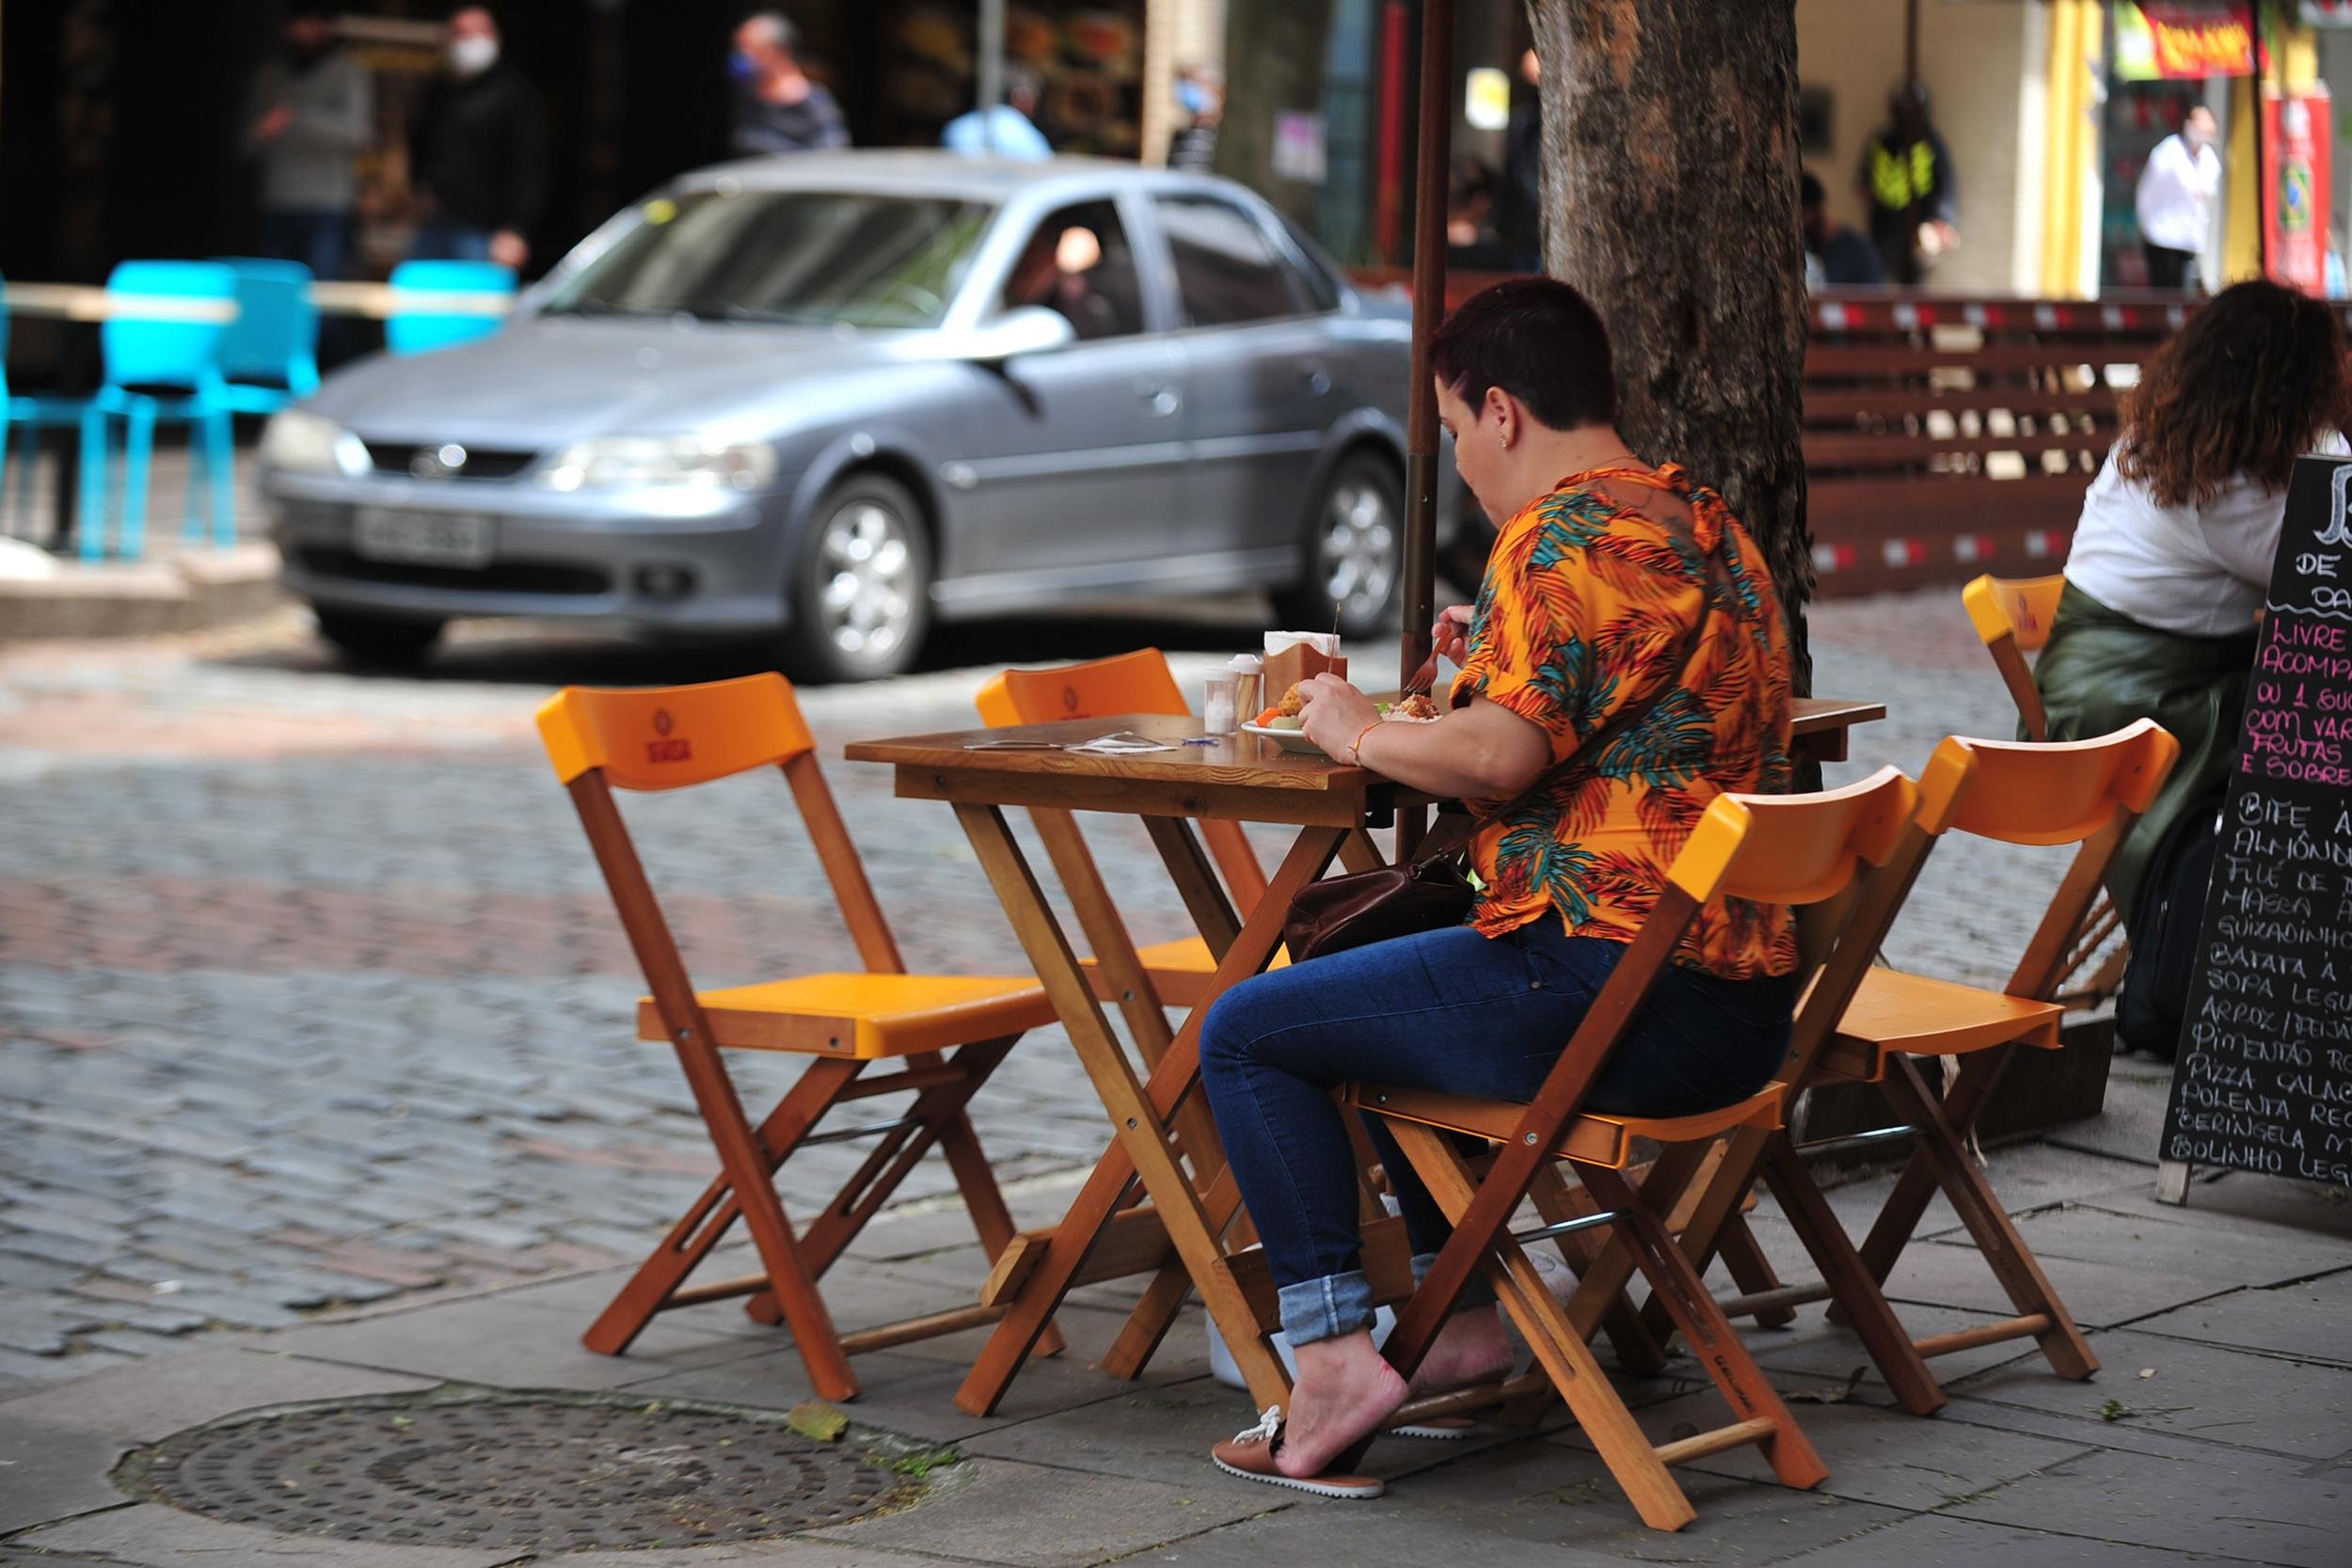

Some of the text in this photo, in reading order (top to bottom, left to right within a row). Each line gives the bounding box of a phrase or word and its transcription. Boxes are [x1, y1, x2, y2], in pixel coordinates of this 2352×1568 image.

[2296, 552, 2342, 578] DE
[2273, 617, 2346, 651] LIVRE
[2241, 753, 2254, 774] E
[2249, 728, 2343, 765] FRUTAS
[2238, 791, 2312, 829] BIFE
[2297, 871, 2328, 892] DE
[2211, 942, 2307, 979] BATATA
[2206, 968, 2275, 999] SOPA
[2182, 1079, 2289, 1120] POLENTA
[2170, 1132, 2352, 1188] BOLINHO LEG
